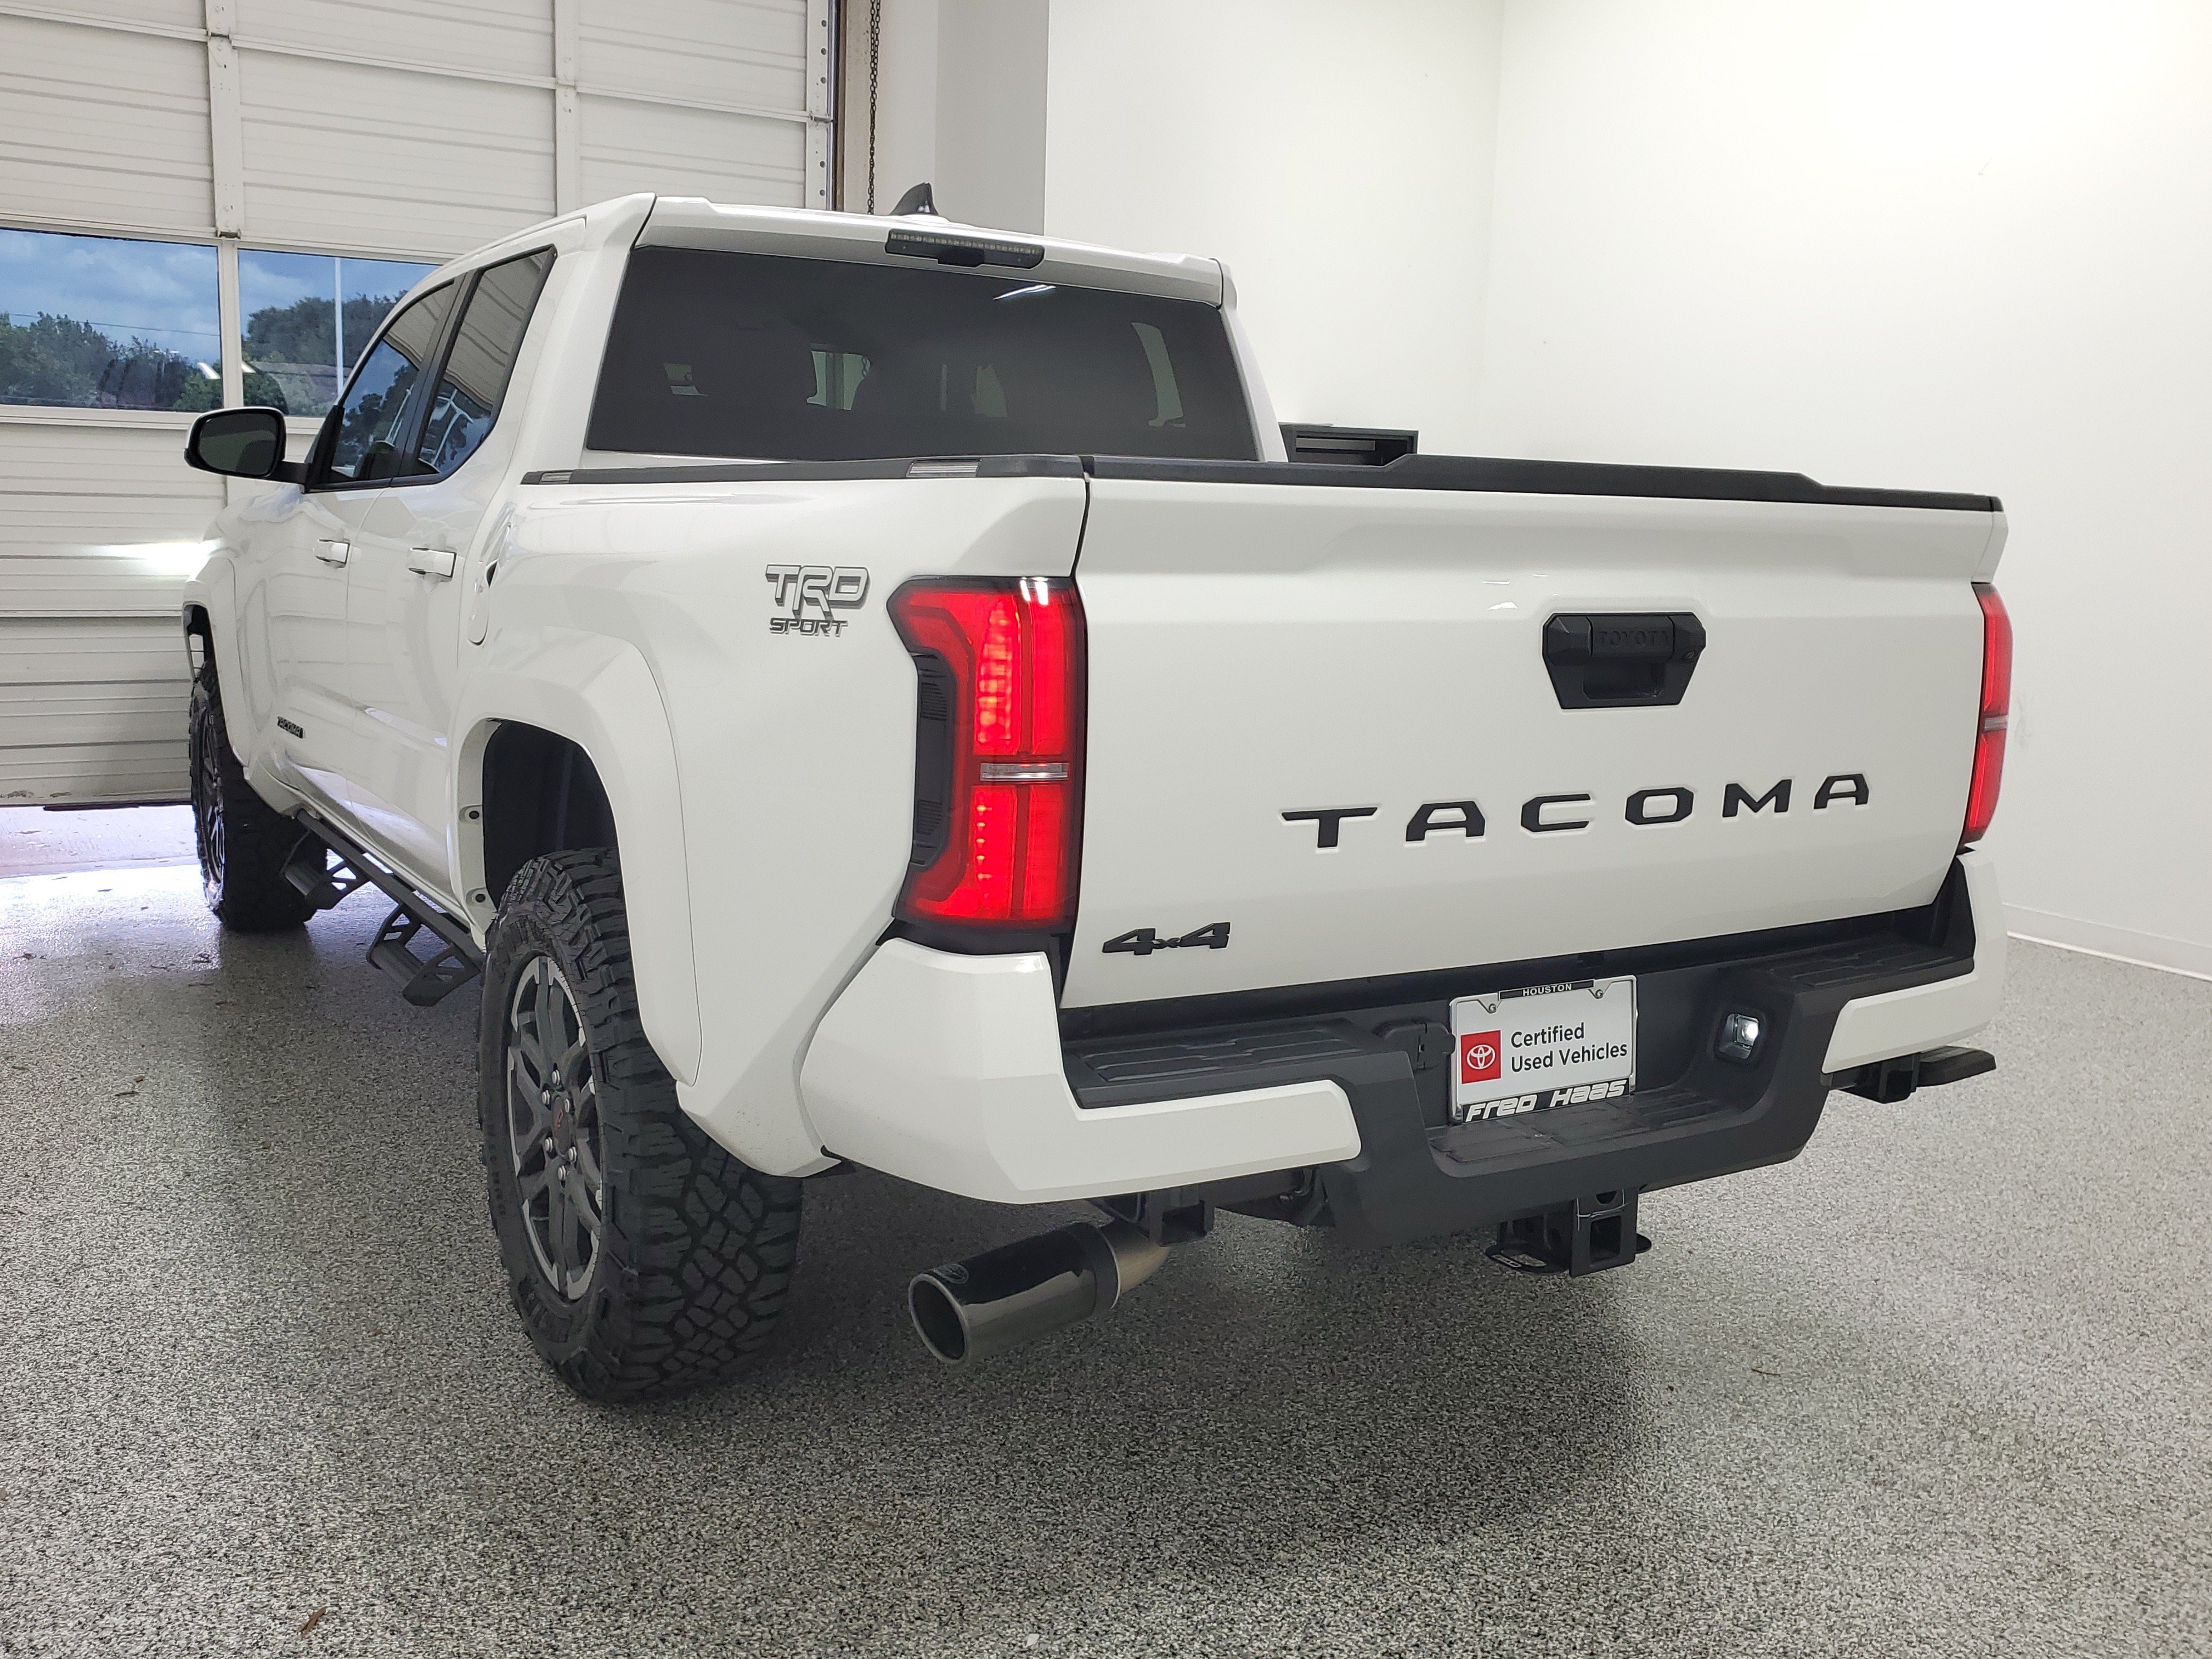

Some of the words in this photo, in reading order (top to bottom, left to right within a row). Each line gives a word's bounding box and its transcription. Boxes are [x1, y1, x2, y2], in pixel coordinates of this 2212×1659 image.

[765, 564, 871, 619] TRD
[770, 618, 848, 637] SPORT
[1596, 630, 1669, 647] TOYOTA
[1281, 772, 1870, 849] TACOMA
[1522, 983, 1572, 996] HOUSTON
[1511, 1022, 1584, 1048] Certified
[1511, 1051, 1553, 1073] Used
[1559, 1042, 1627, 1065] Vehicles
